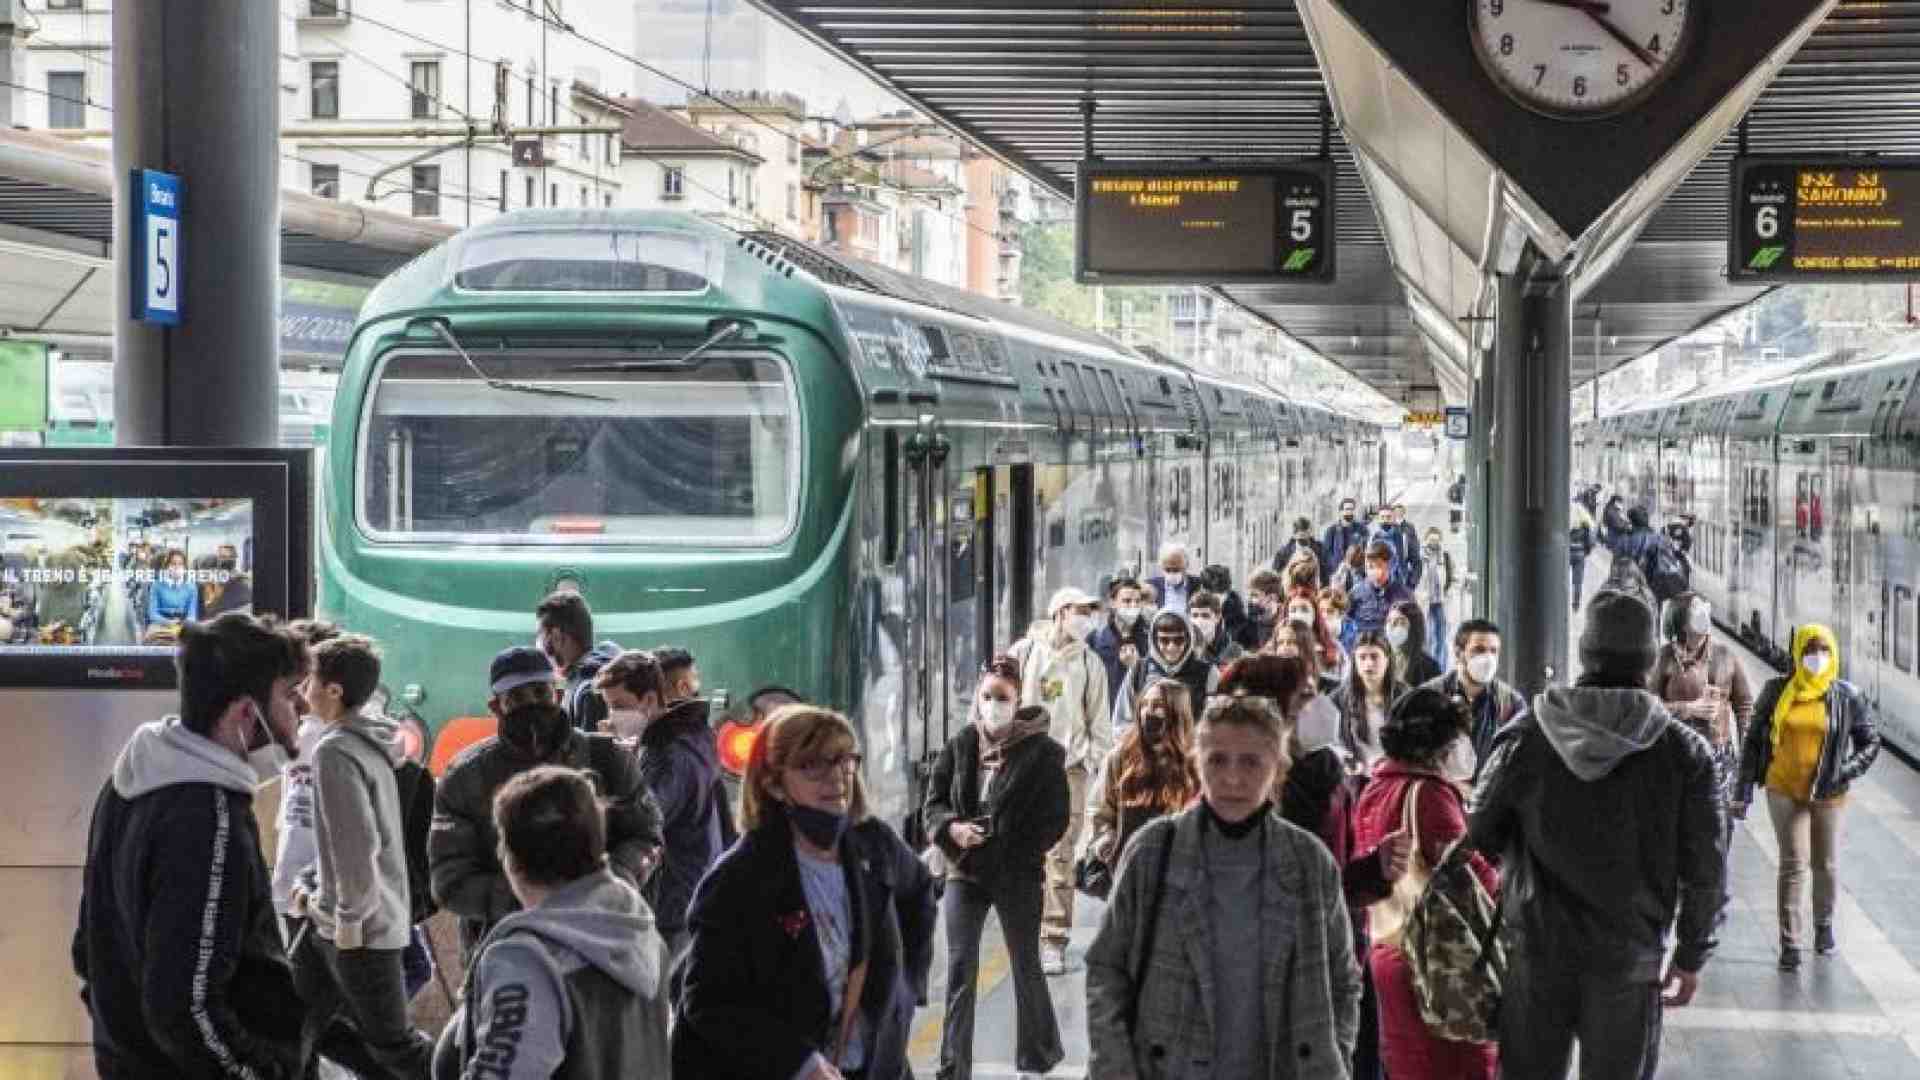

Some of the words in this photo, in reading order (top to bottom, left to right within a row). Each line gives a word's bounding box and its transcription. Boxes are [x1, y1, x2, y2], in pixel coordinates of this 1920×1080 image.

[1501, 33, 1514, 56] 8
[1648, 33, 1660, 54] 4
[1533, 64, 1547, 86] 7
[1573, 75, 1586, 97] 6
[1617, 64, 1629, 86] 5
[1290, 209, 1312, 242] 5
[1756, 206, 1779, 238] 6
[156, 228, 170, 298] 5
[4, 568, 19, 583] IL
[23, 568, 75, 583] TRENO
